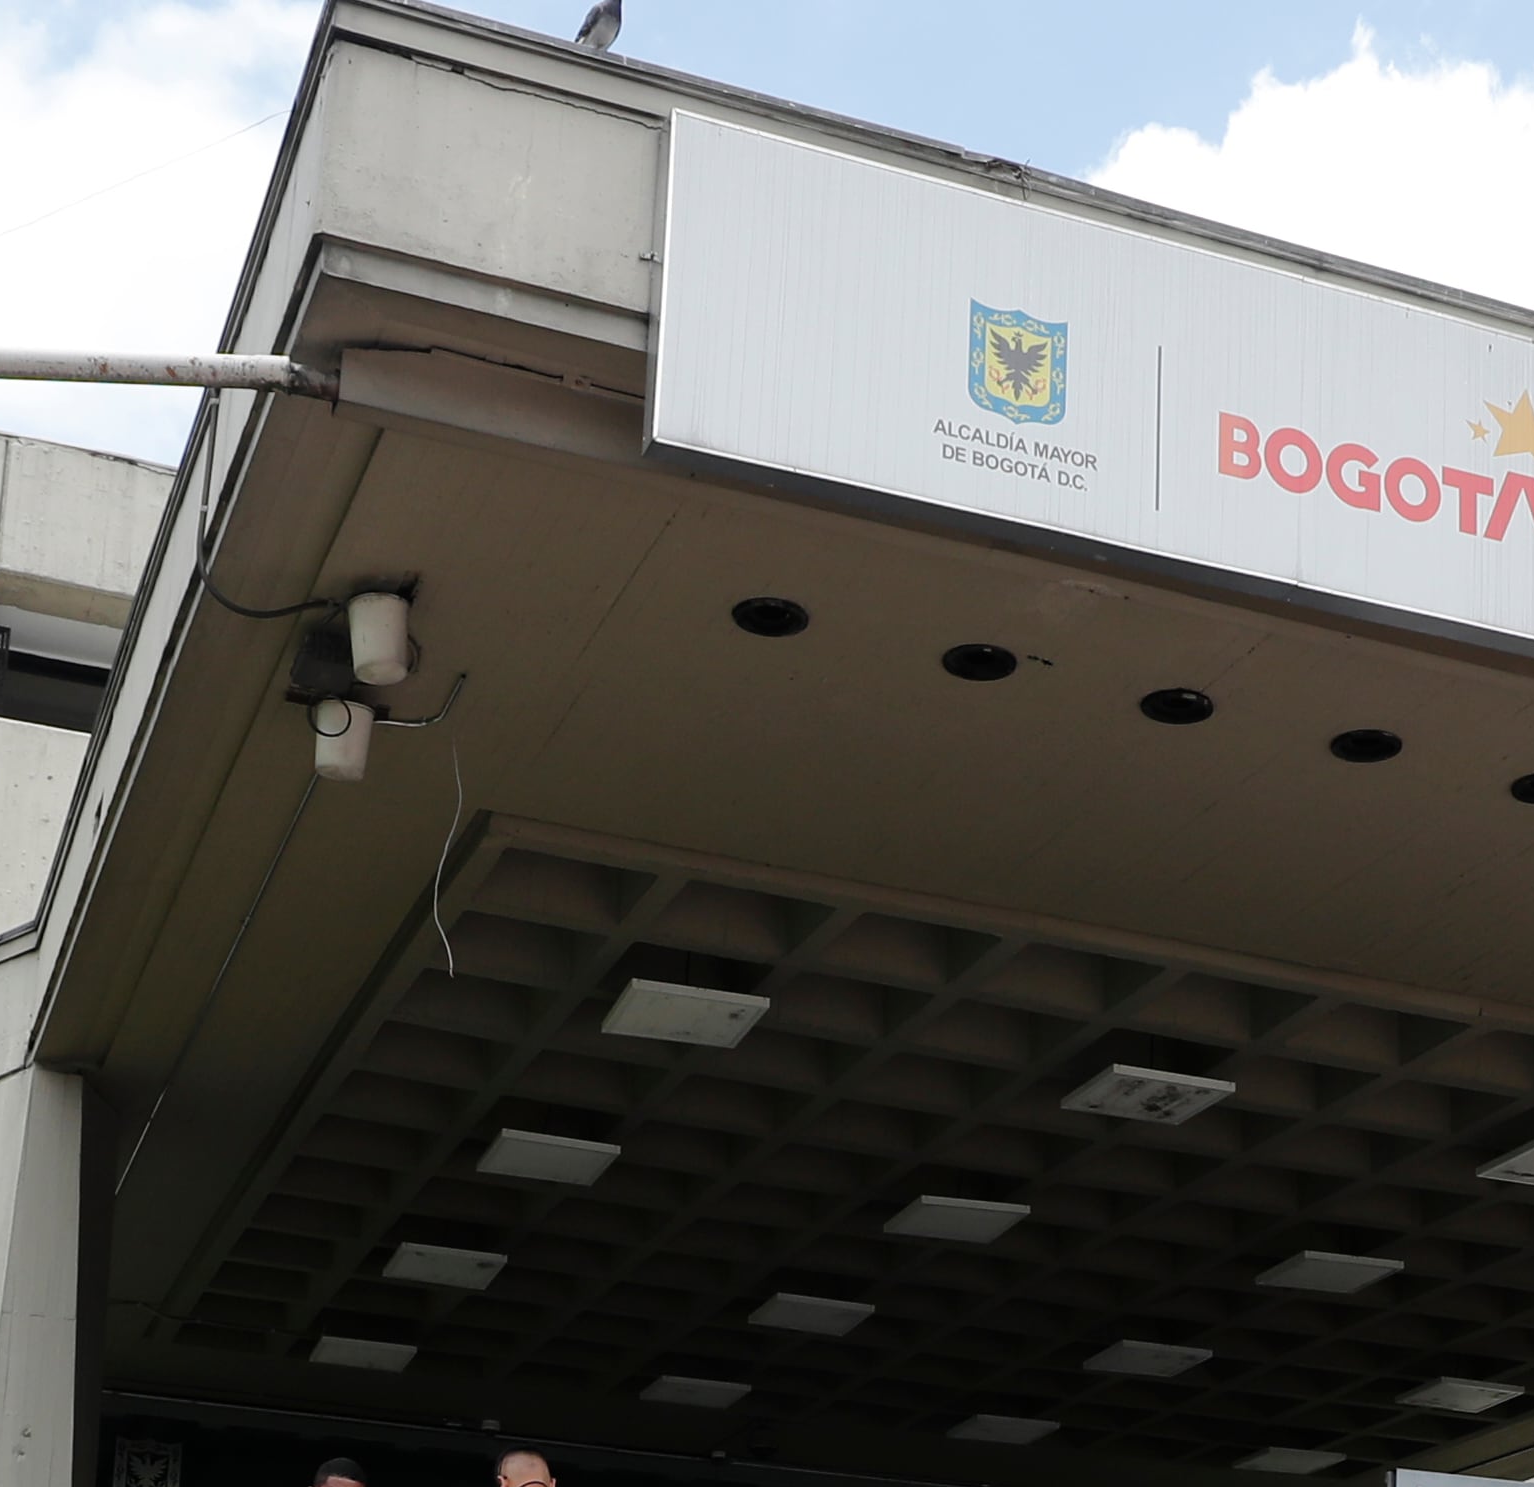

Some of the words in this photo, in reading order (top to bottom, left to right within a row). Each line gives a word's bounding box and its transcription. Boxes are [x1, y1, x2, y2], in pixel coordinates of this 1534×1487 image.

[933, 418, 1028, 455] ALCALDÍA
[1034, 441, 1099, 472] MAYOR
[942, 443, 967, 464] DE
[972, 449, 1051, 483] BOGOTÁ
[1057, 470, 1089, 492] D.C.
